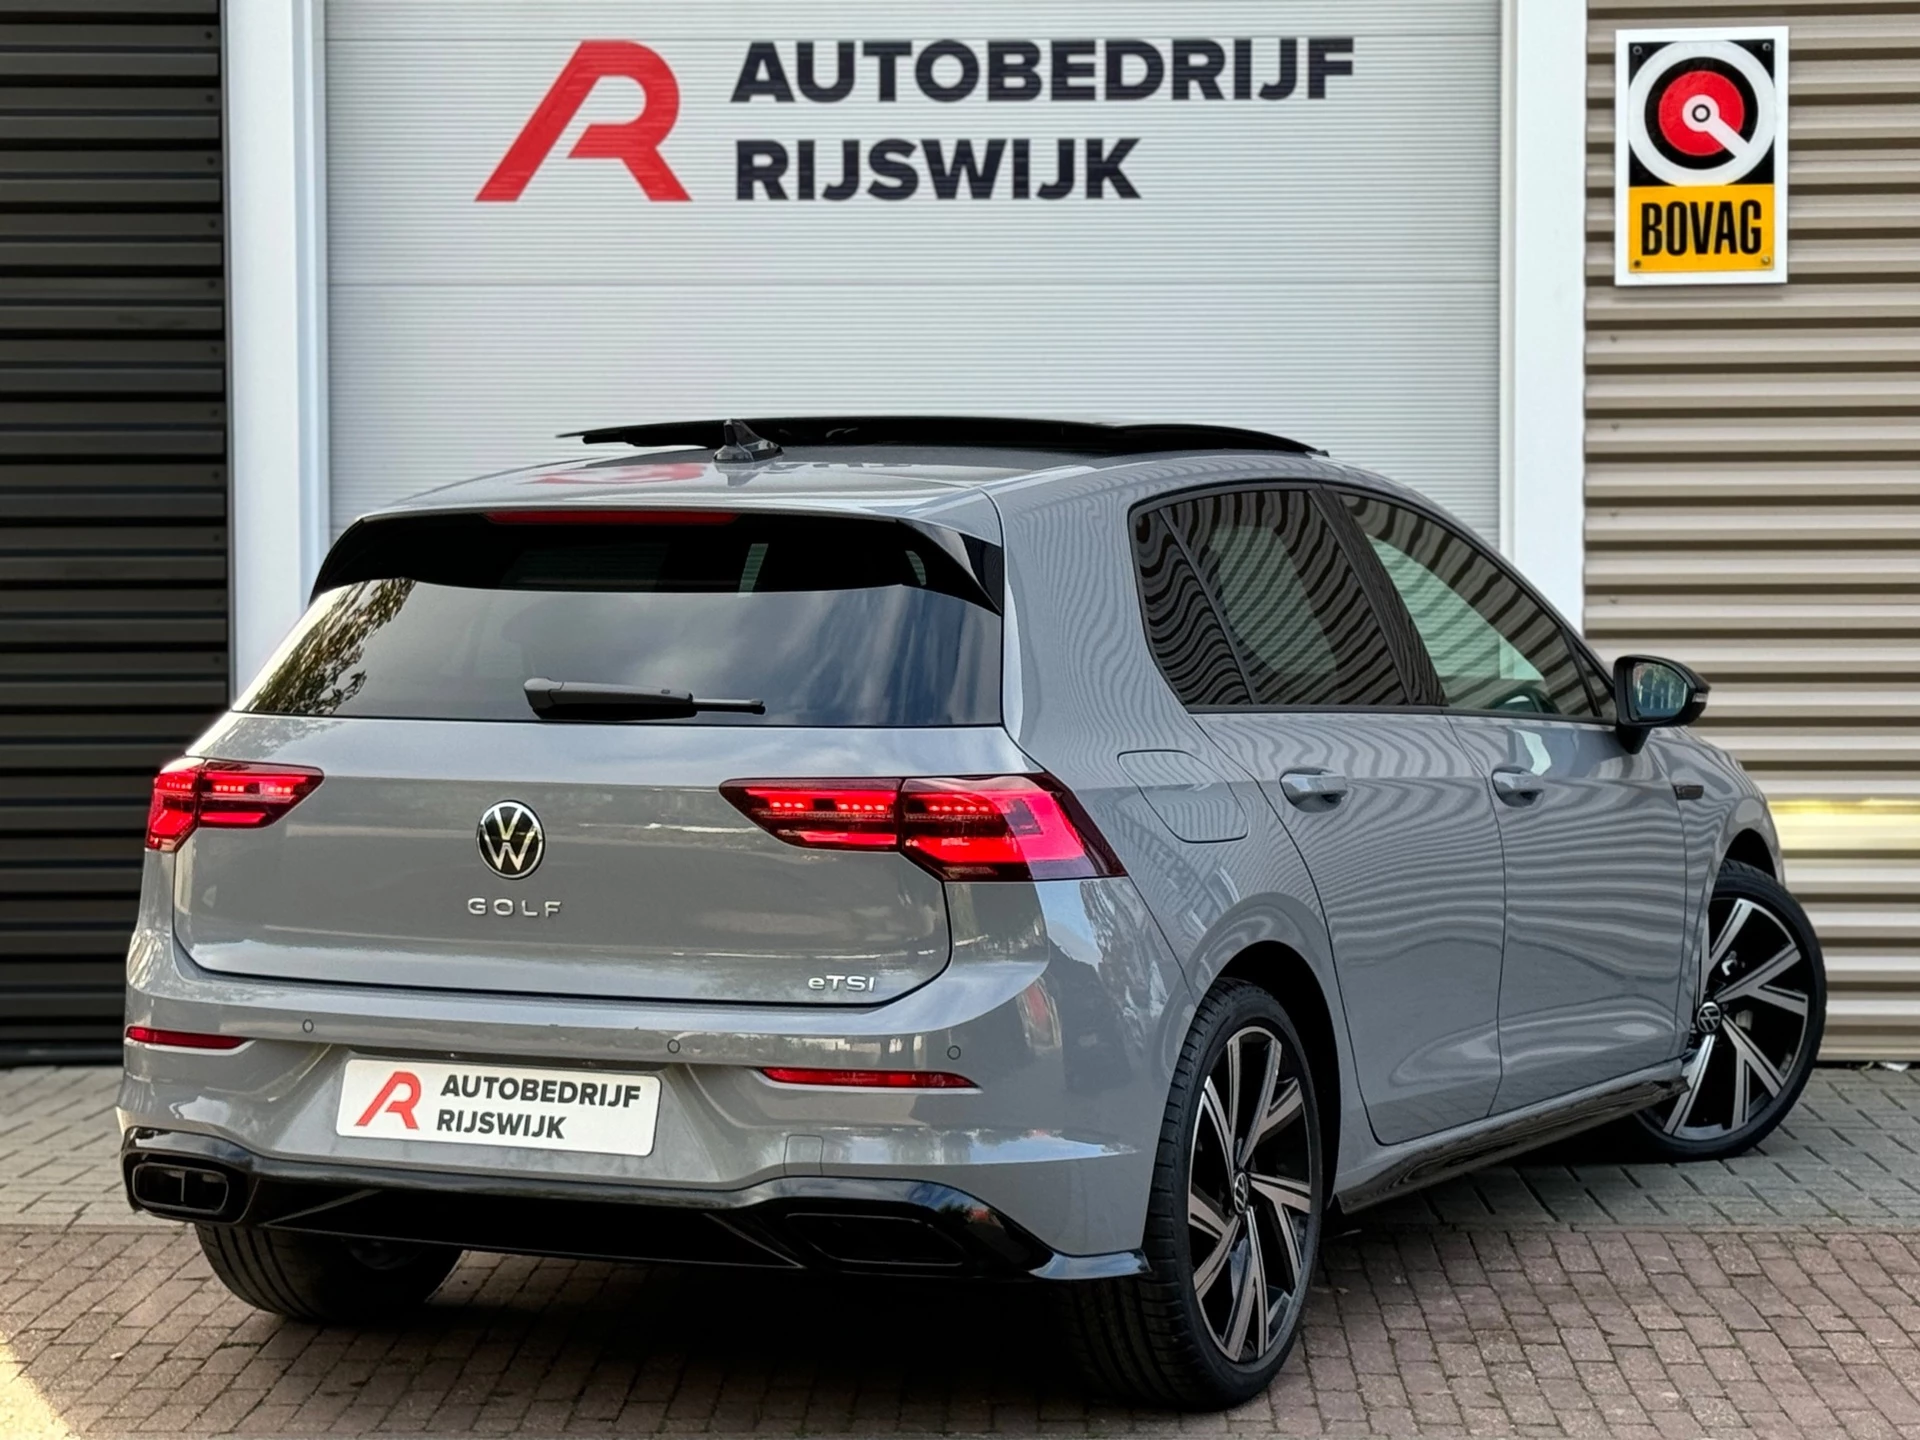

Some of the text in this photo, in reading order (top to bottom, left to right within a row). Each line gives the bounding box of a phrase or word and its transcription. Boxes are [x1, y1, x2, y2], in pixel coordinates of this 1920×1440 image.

[731, 38, 1355, 103] AUTOBEDRIJF
[735, 138, 1142, 201] RIJSWIJK
[1641, 199, 1762, 256] BOVAG
[467, 897, 562, 917] GOLF
[808, 974, 875, 991] eTSI
[440, 1074, 641, 1108] AUTOBEDRIJF
[436, 1109, 567, 1139] RIJSWIJK
